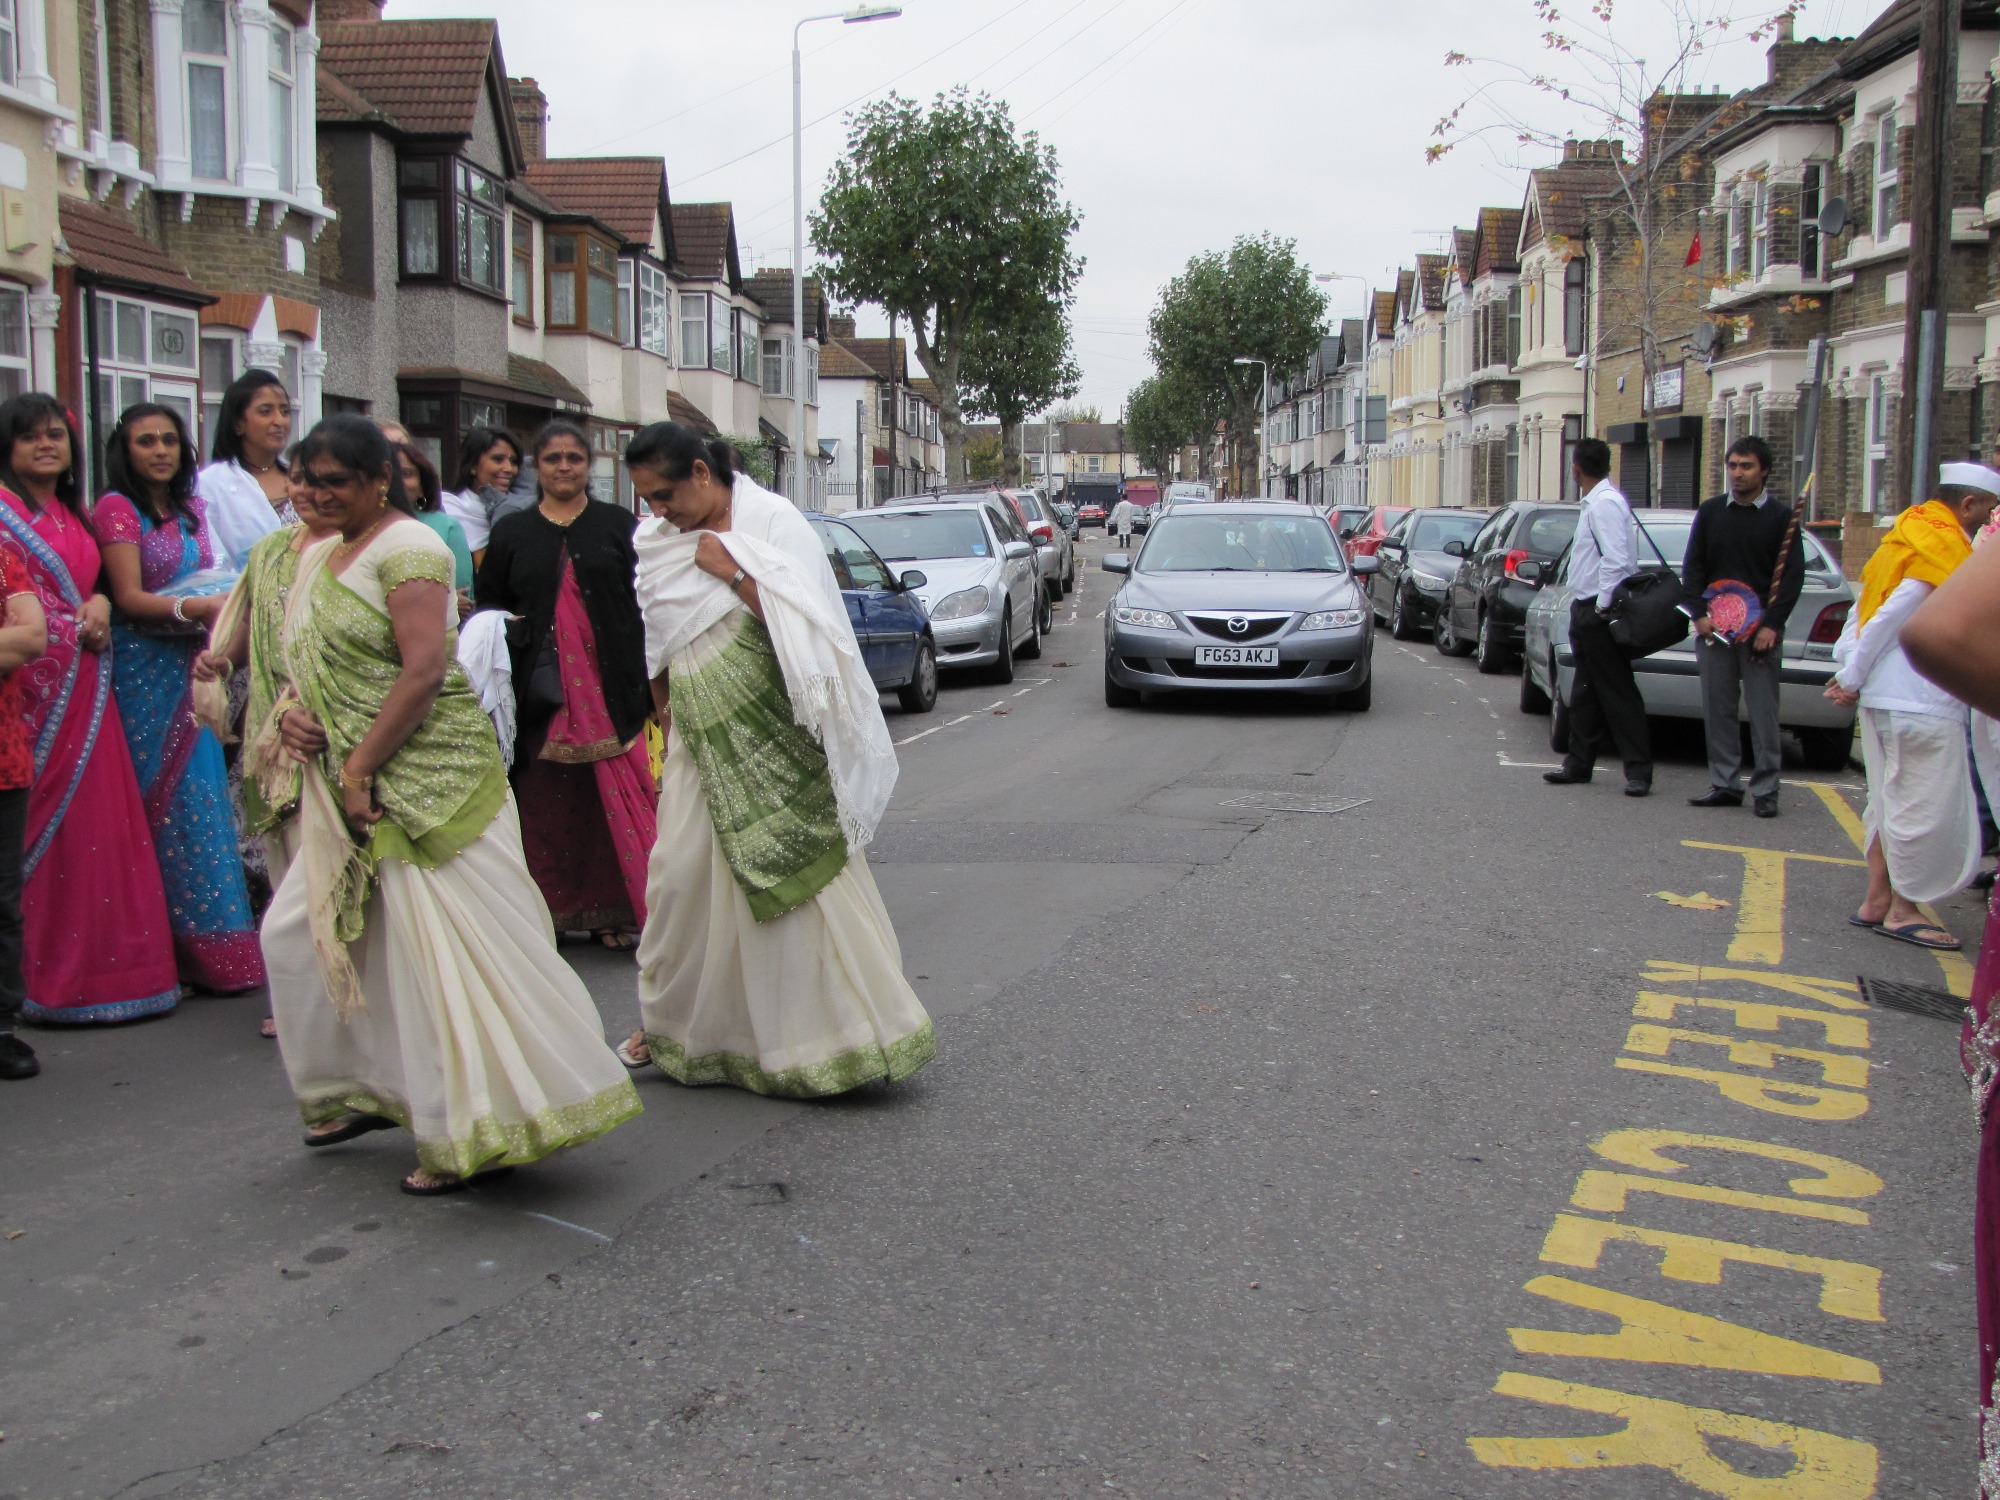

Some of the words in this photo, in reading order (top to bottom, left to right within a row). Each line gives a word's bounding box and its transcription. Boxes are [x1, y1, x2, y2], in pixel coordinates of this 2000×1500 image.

[1203, 648, 1240, 662] FG53
[1245, 649, 1273, 663] AKJ
[1614, 960, 1871, 1120] KEEP
[1466, 1127, 1886, 1500] CLEAR
